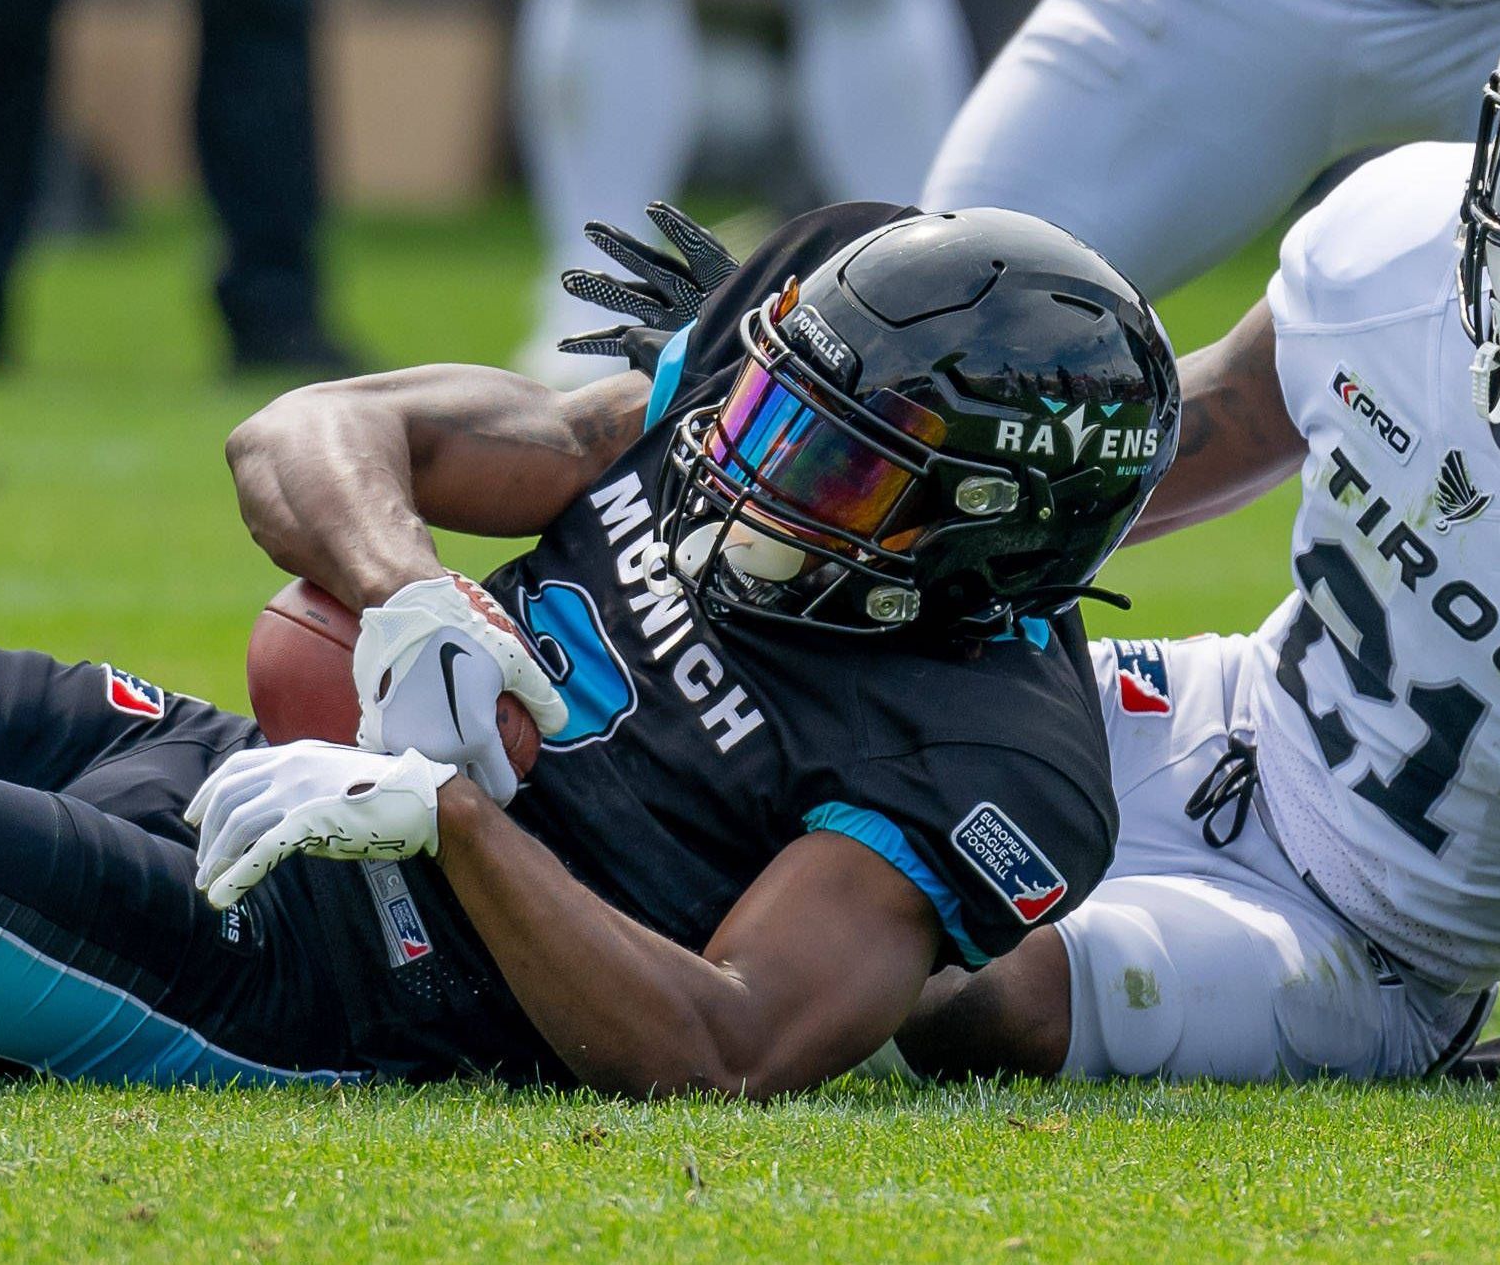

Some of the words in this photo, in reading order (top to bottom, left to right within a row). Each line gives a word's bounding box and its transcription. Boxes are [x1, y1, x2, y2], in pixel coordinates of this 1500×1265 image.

[792, 310, 846, 368] FORELLE
[996, 403, 1158, 466] RAVENS
[1116, 464, 1153, 477] MUNICH
[589, 471, 765, 755] MUNICH
[1279, 536, 1495, 862] 21
[960, 829, 1010, 881] FOOTBALL
[970, 820, 1010, 861] LEAGUE
[979, 811, 1031, 866] EUROPEAN
